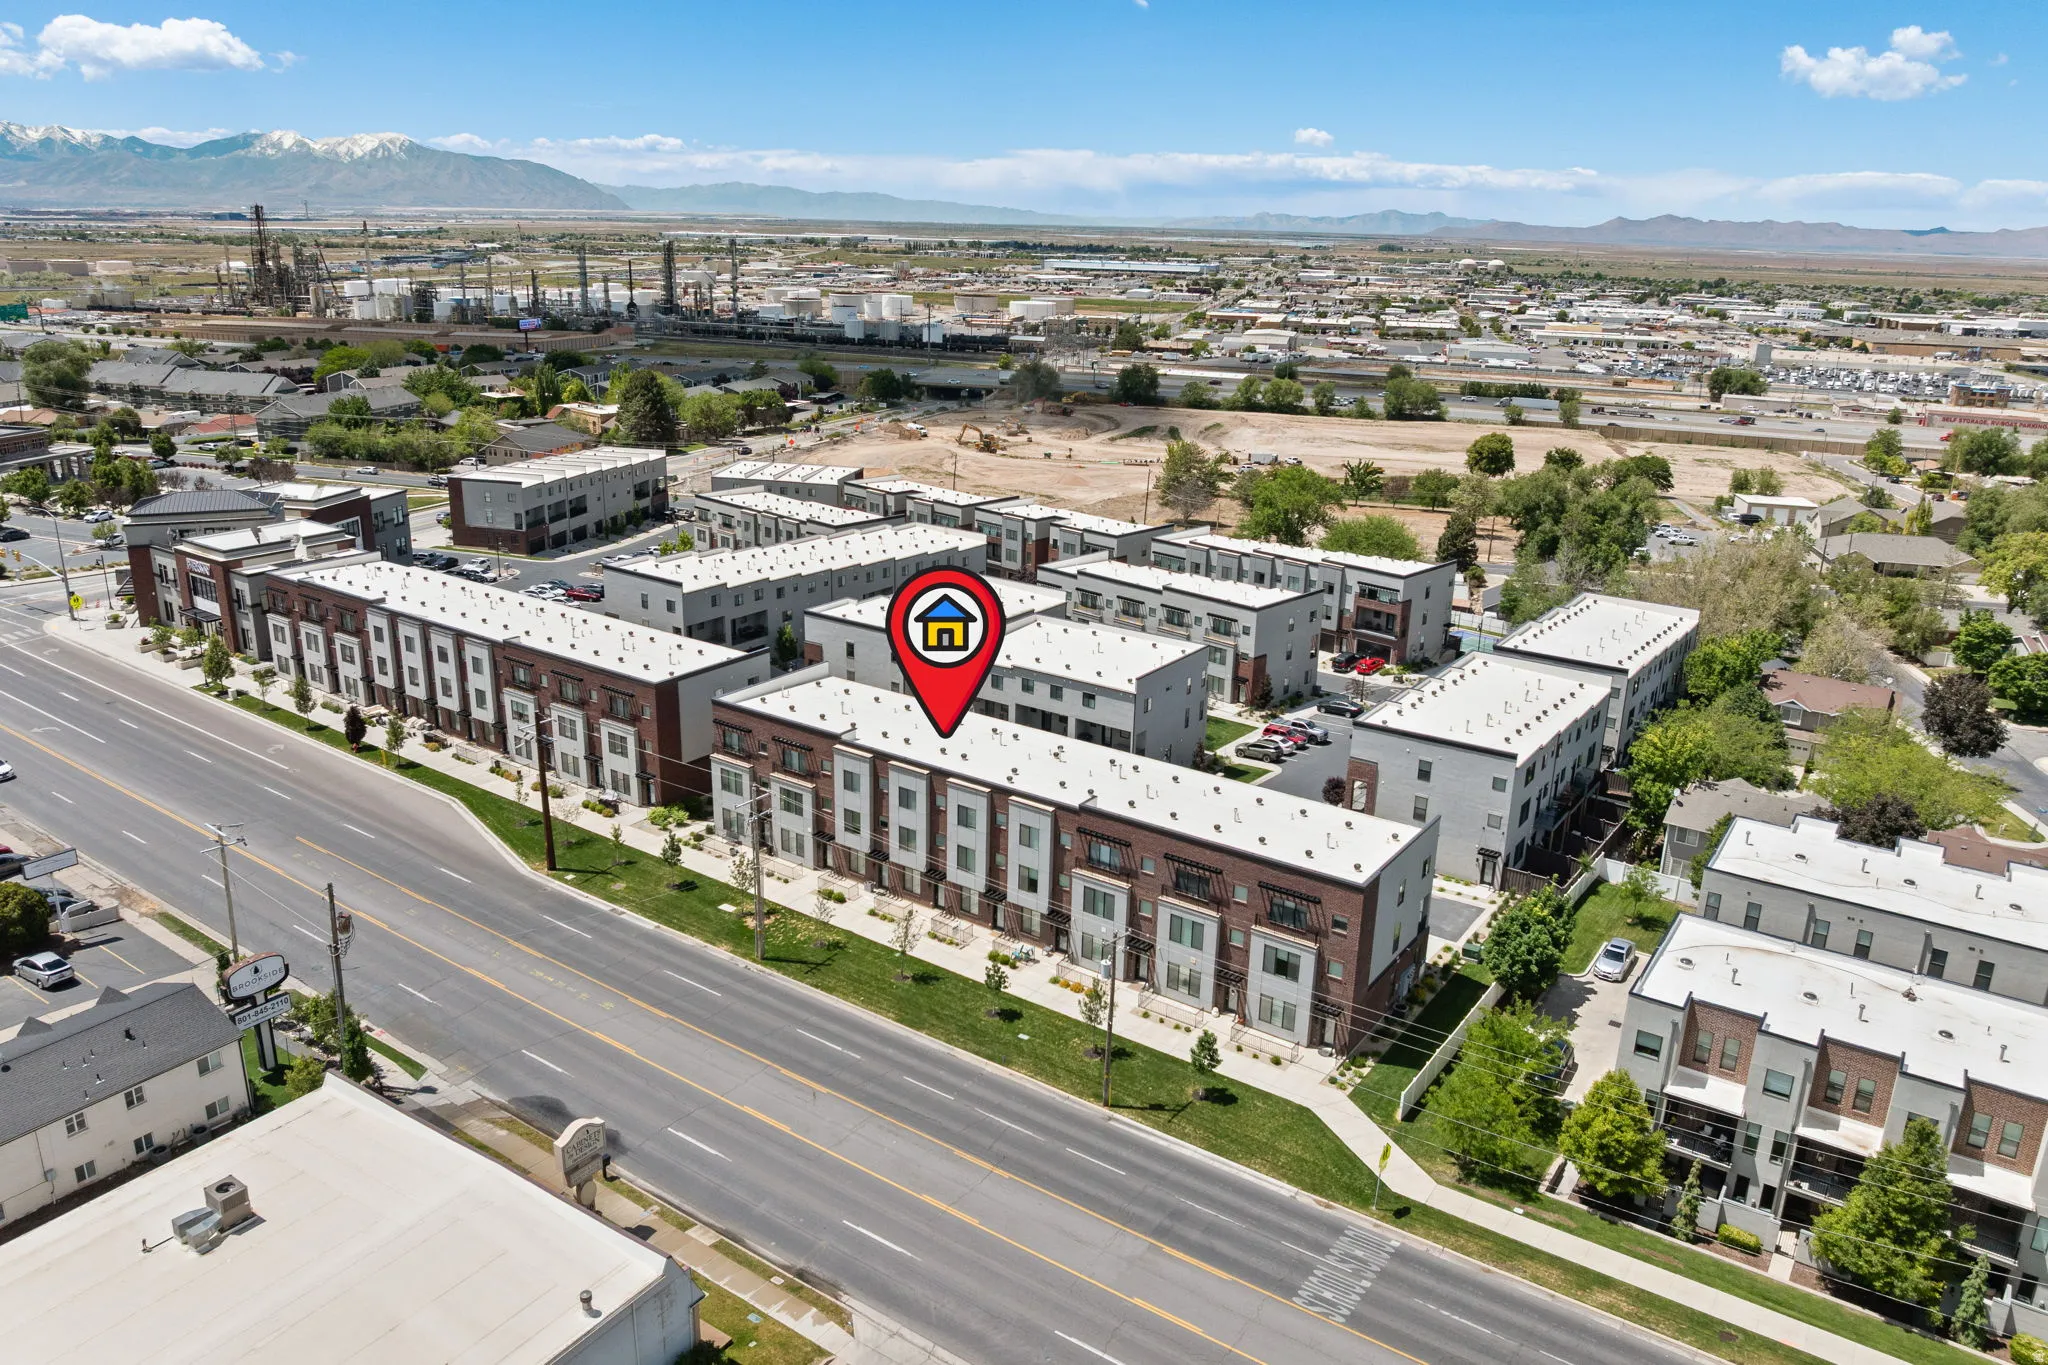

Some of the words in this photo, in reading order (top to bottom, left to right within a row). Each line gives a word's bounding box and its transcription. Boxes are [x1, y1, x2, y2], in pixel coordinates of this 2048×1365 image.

[232, 966, 284, 992] BROOKSIDE
[238, 996, 288, 1024] 801-845-2110
[1324, 1224, 1400, 1279] SCHOOL
[1291, 1264, 1373, 1324] SCHOOL
